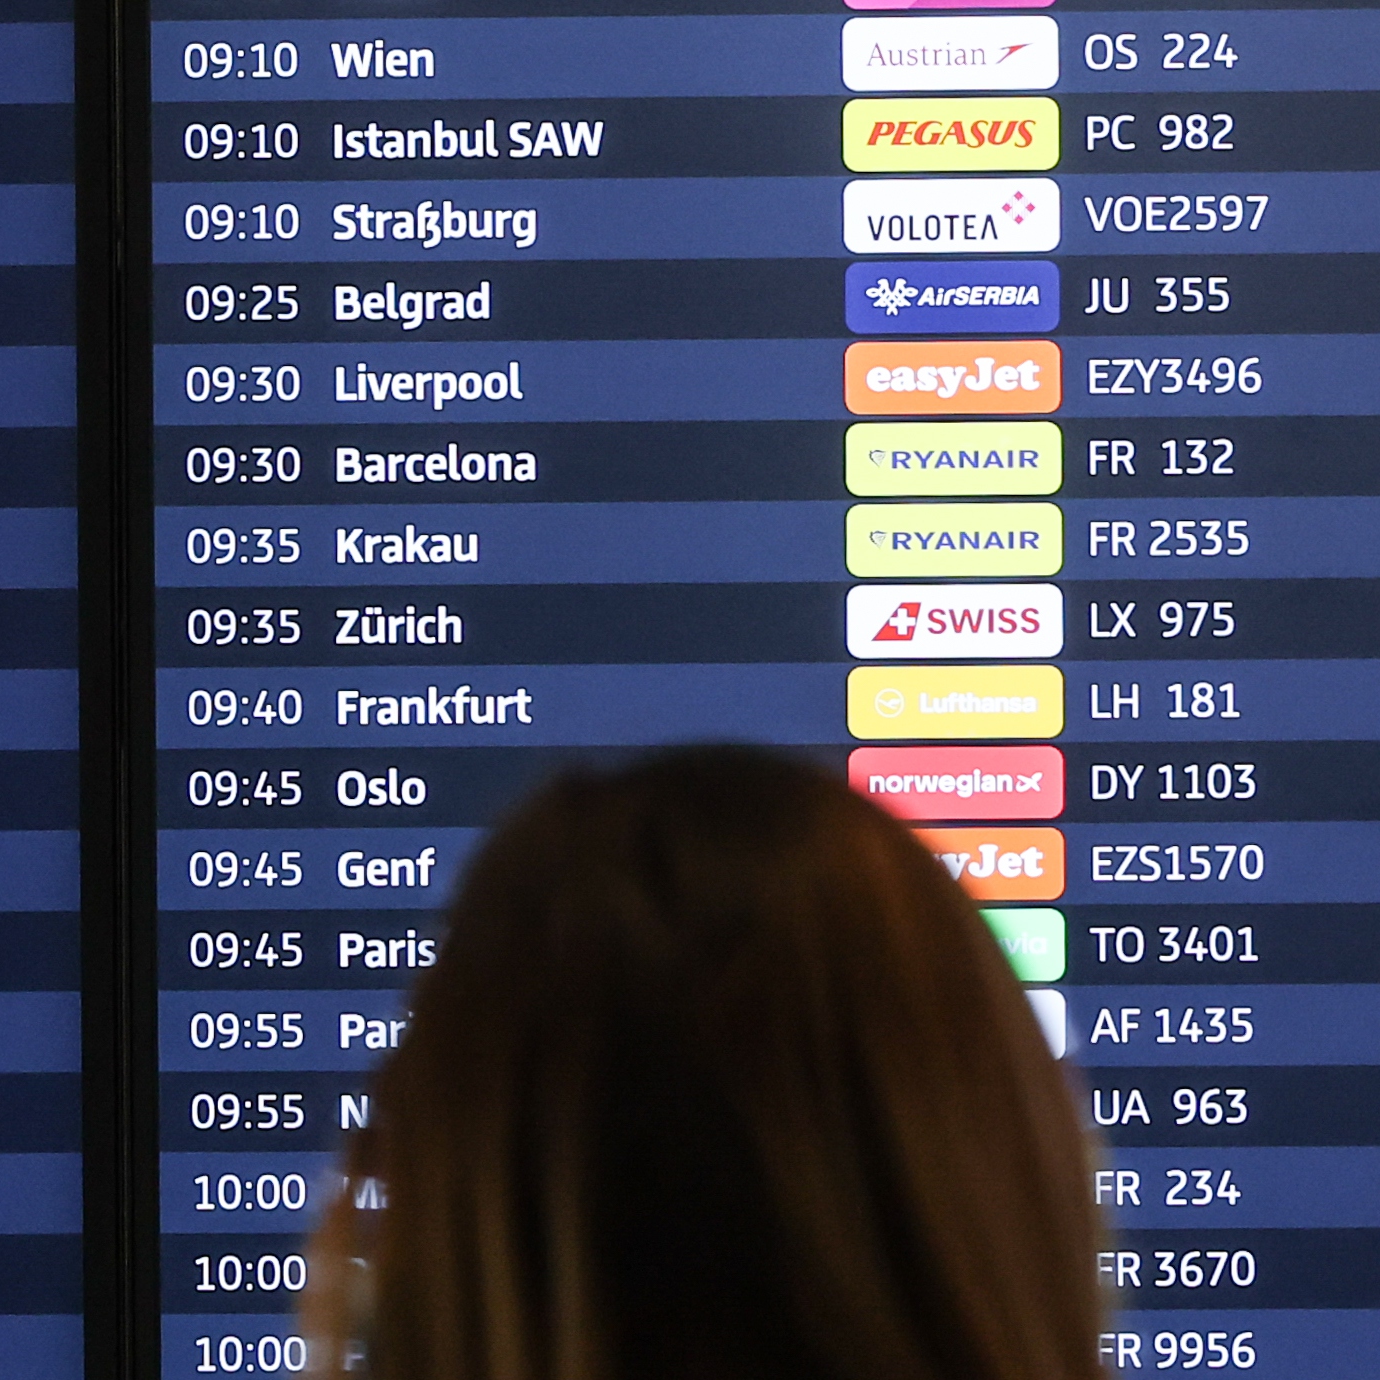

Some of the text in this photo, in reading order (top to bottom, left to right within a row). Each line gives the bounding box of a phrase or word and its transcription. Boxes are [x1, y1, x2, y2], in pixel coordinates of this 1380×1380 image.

[185, 43, 297, 78] 09:10
[332, 40, 433, 77] Wien
[1085, 33, 1238, 69] OS 224
[335, 120, 603, 158] Istanbul SAW
[867, 120, 1035, 148] PEGASUS
[186, 204, 298, 240] 09:10
[334, 201, 536, 248] Straßburg
[1085, 196, 1268, 231] VOE2597
[336, 282, 489, 329] Belgrad
[187, 366, 299, 402] 09:30
[336, 362, 522, 410] Liverpool
[1090, 358, 1261, 393] EZY3496
[337, 444, 535, 482] Barcelona
[188, 529, 299, 564] 09:35
[337, 525, 477, 563] Krakau
[1091, 521, 1248, 556] FR 2535
[336, 606, 461, 644] Zürich
[189, 690, 301, 725] 09:40
[338, 686, 531, 725] Frankfurt
[919, 692, 1038, 713] Lufthansa
[1092, 683, 1239, 718] LH 181
[338, 768, 425, 806] Oslo
[870, 769, 1012, 797] norwegian
[190, 852, 301, 887] 09:45
[338, 848, 434, 887] Genf
[1093, 845, 1263, 881] EZS1570
[340, 930, 435, 967] Paris
[191, 1013, 303, 1048] 09:55
[1092, 1008, 1253, 1043] AF 1435
[195, 1174, 305, 1209] 10:00
